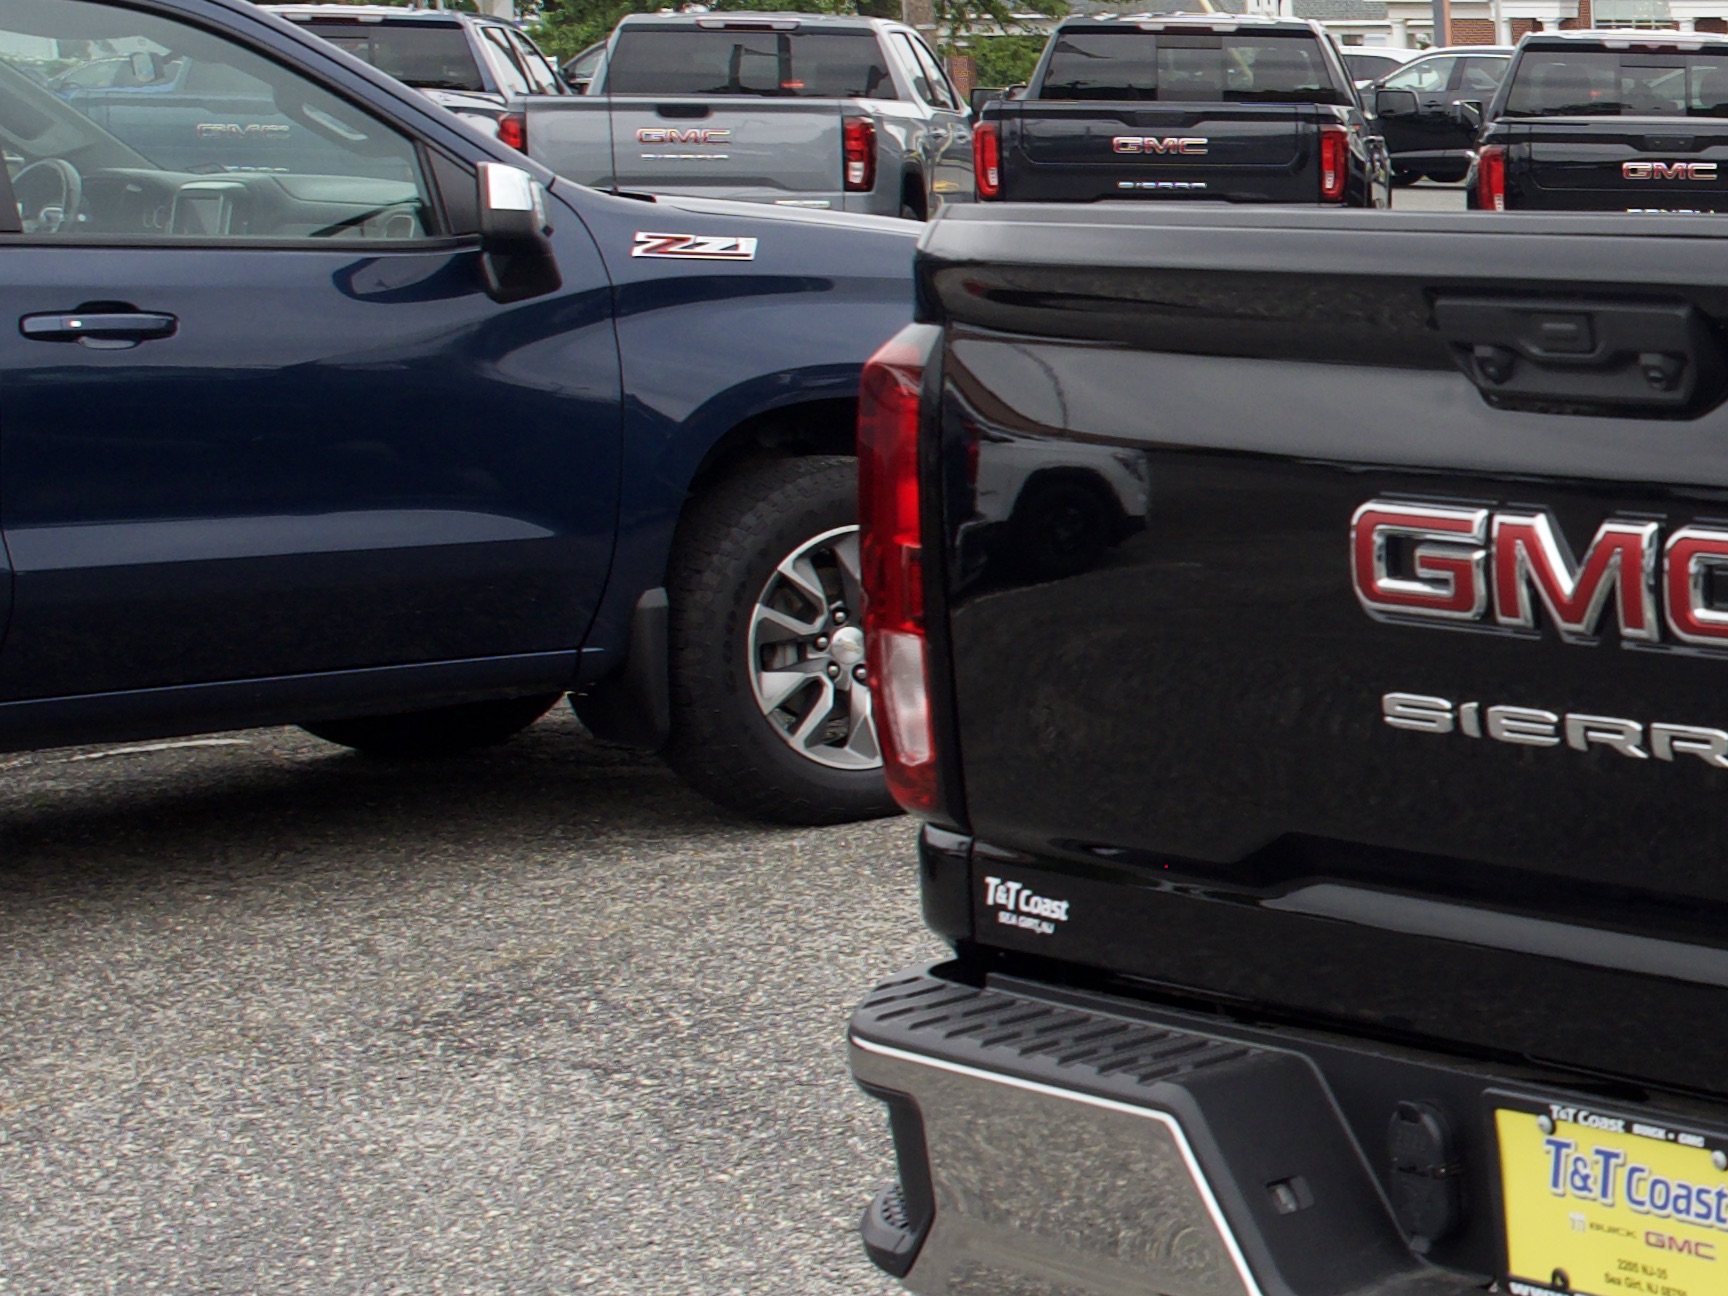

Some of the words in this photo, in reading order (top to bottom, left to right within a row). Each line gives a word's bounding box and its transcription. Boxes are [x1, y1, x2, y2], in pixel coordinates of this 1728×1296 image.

[636, 128, 731, 144] GMC
[1112, 136, 1208, 154] GMC
[1622, 162, 1718, 180] GMC
[631, 231, 758, 261] Z71
[985, 876, 1022, 911] T&T
[1578, 1110, 1625, 1133] Coast
[1545, 1136, 1624, 1206] T&T
[1645, 1230, 1716, 1261] GMC
